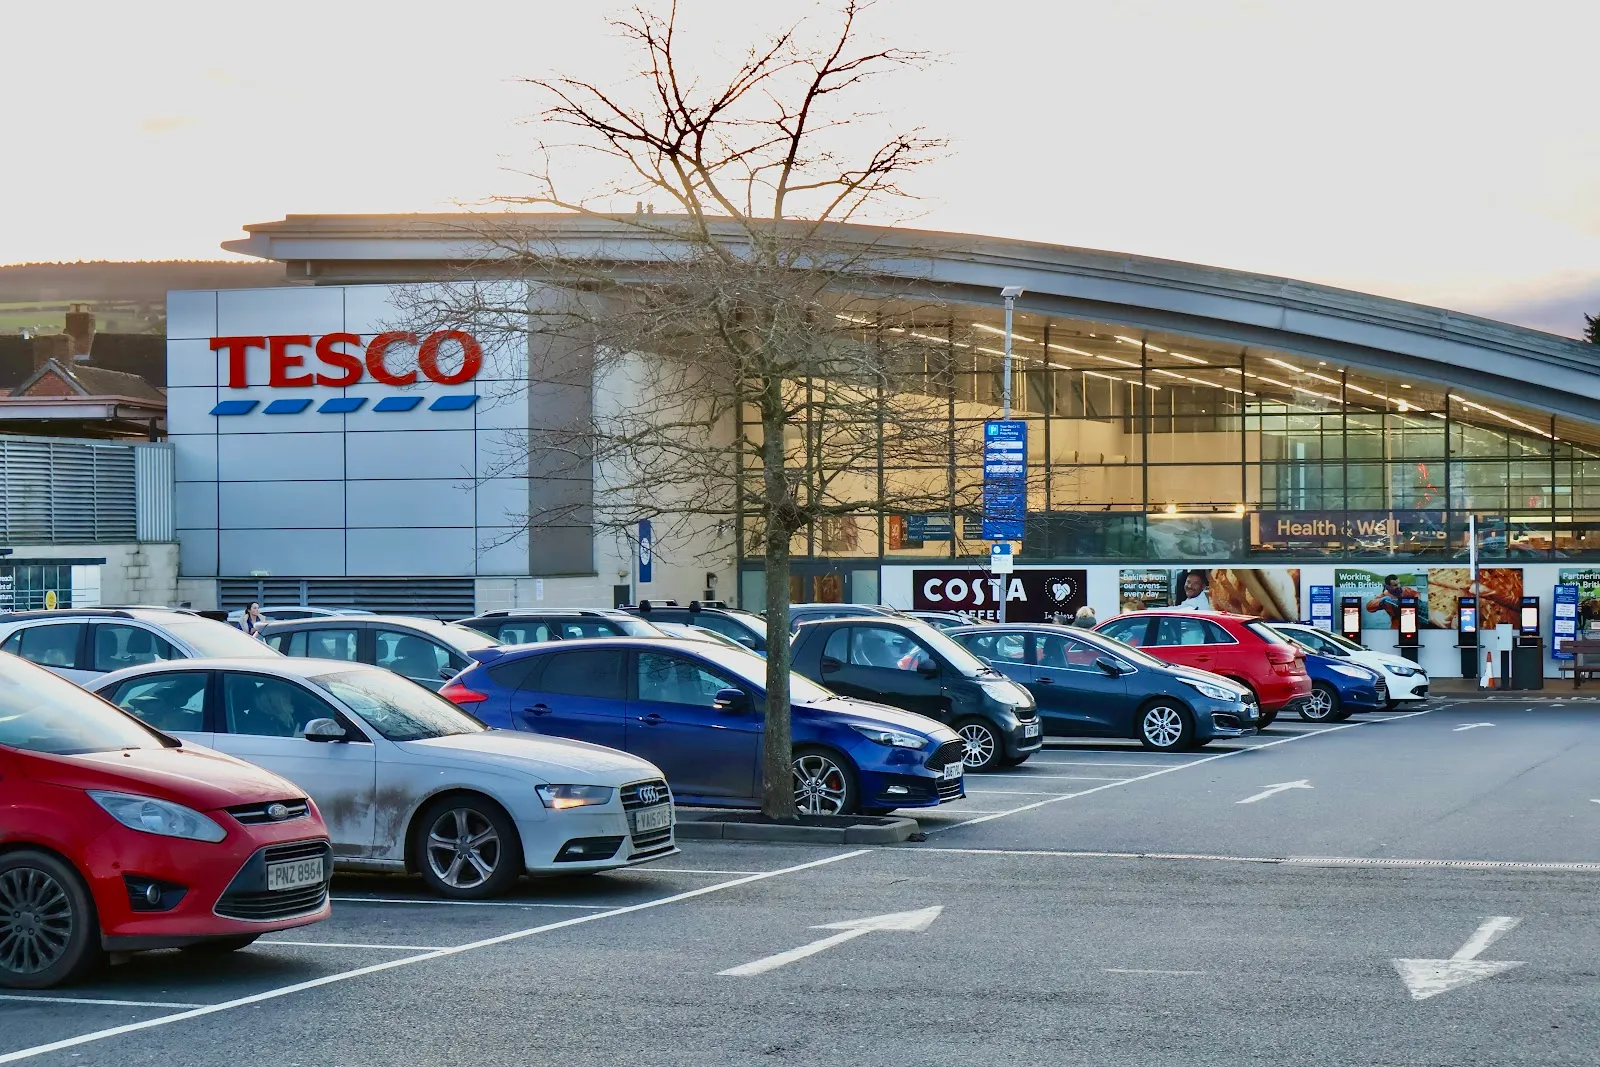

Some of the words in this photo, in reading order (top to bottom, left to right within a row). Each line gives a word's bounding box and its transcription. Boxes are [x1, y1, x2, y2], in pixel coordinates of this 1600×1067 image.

[210, 329, 483, 388] TESCO
[1277, 519, 1337, 536] Health
[1123, 574, 1147, 582] Baking
[1339, 573, 1371, 581] Working
[1563, 572, 1600, 580] Partnerin
[923, 577, 1028, 606] COSTA
[1123, 591, 1144, 599] every
[1146, 590, 1160, 599] day
[1044, 611, 1053, 620] In
[275, 865, 295, 885] PNZ
